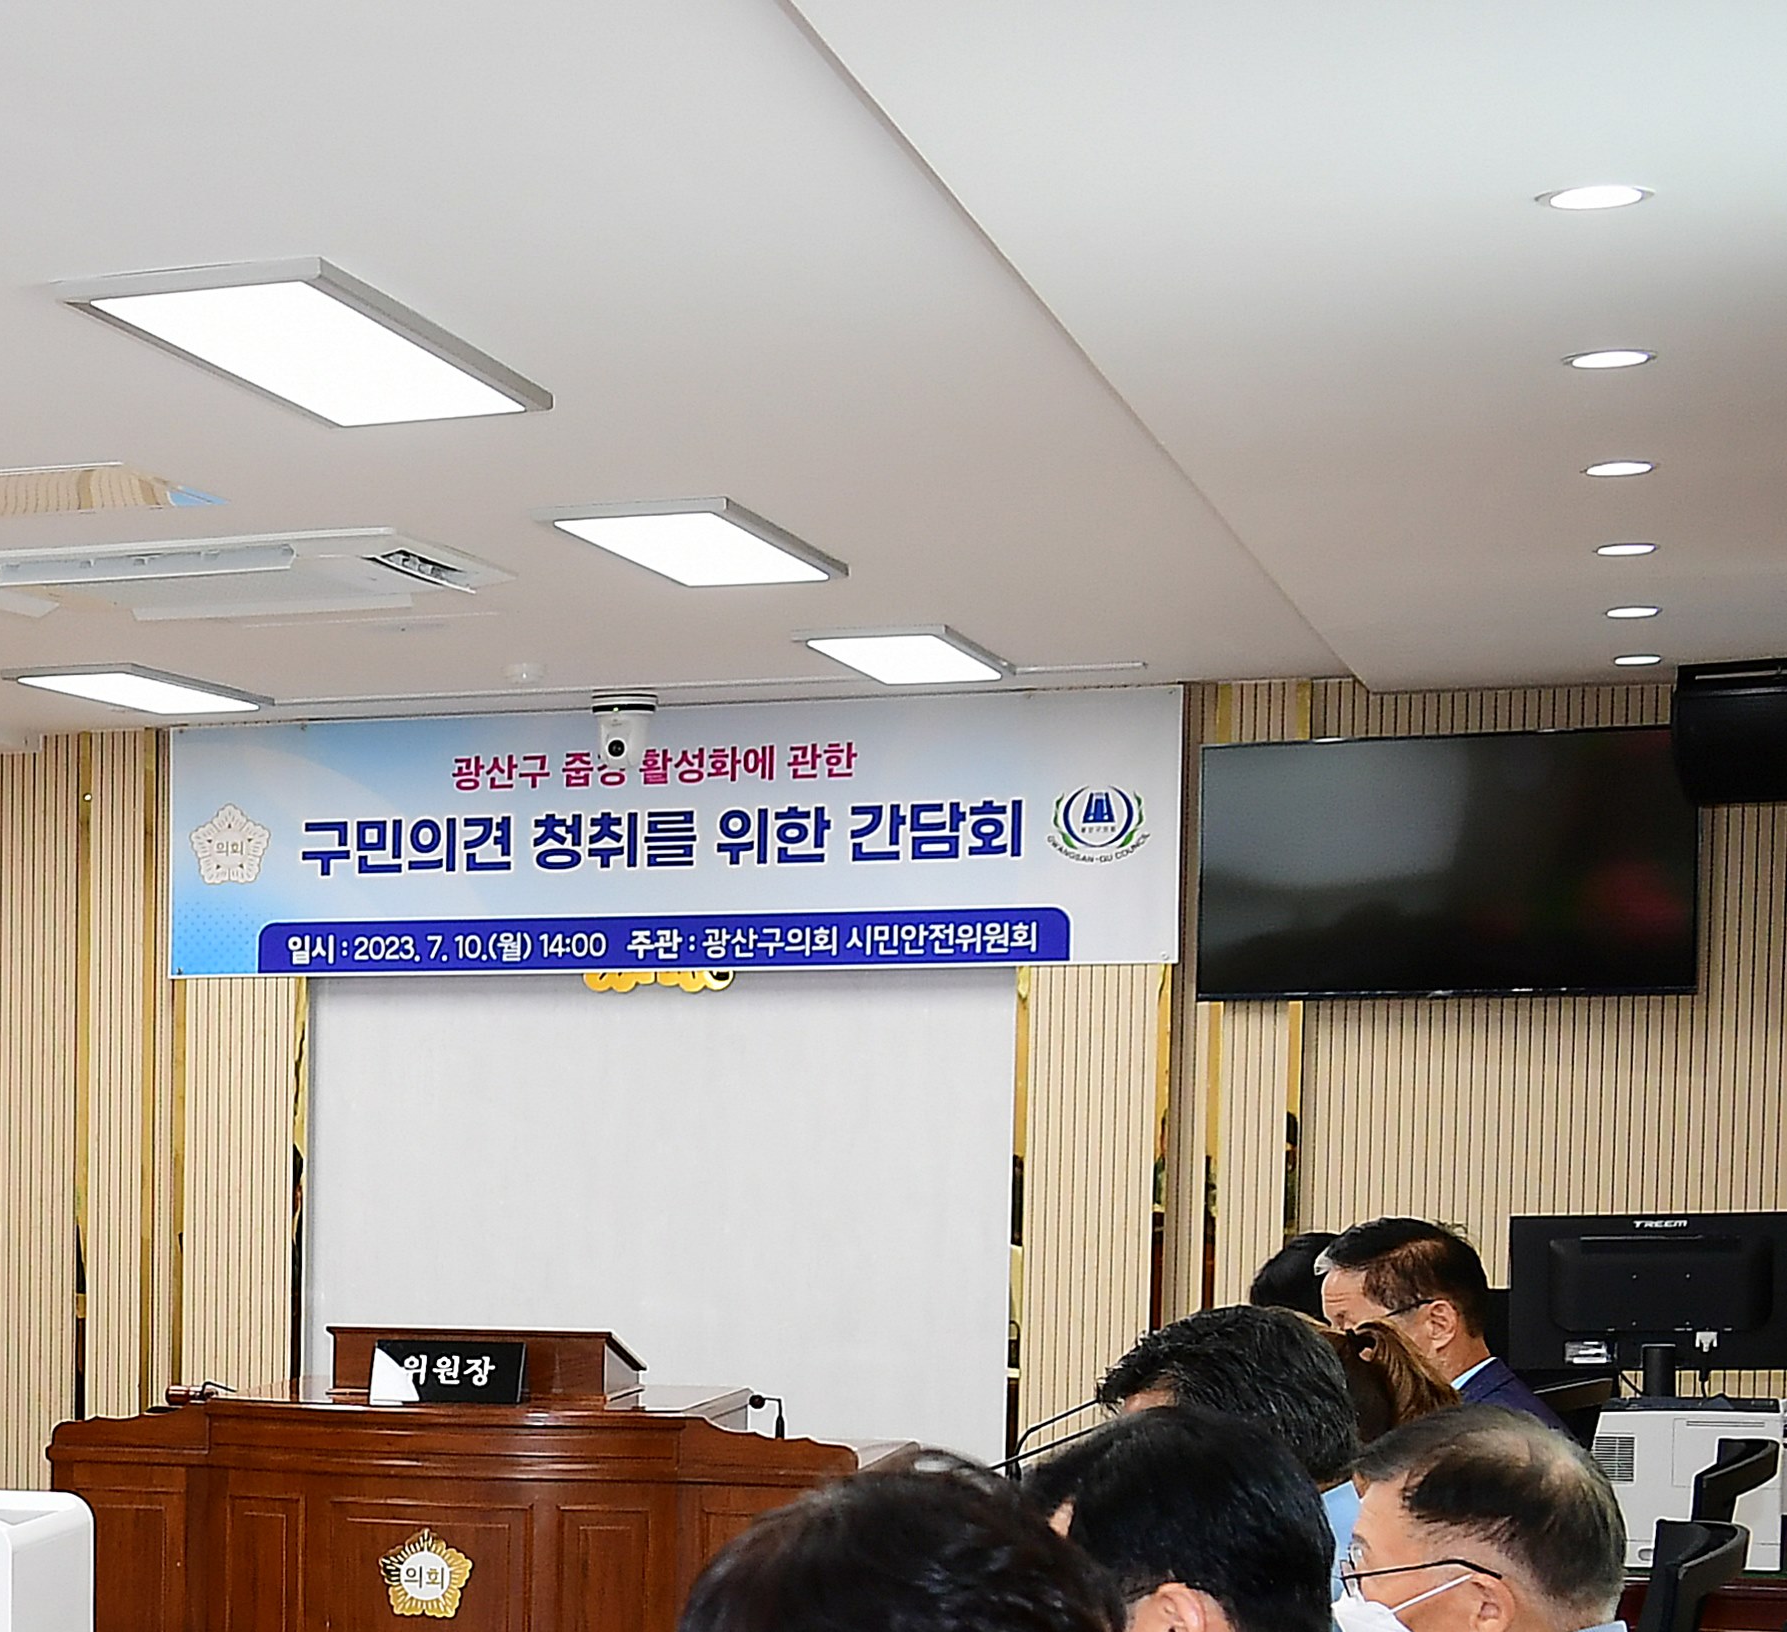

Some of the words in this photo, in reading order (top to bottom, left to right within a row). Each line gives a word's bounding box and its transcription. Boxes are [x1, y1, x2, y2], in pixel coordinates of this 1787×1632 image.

[452, 755, 551, 791] 광산구
[640, 744, 776, 784] 활성화에
[787, 741, 857, 779] 관한
[216, 840, 244, 857] 의회
[301, 815, 514, 876] 구민의견
[532, 809, 697, 870] 청취를
[716, 805, 831, 866] 위한
[850, 799, 1024, 863] 간담회
[353, 936, 421, 963] 2023.
[426, 935, 448, 962] 7.
[539, 933, 607, 960] 14:00
[702, 926, 838, 959] 광산구의회
[846, 922, 1039, 955] 시민안전위원회
[403, 1354, 496, 1387] 위원장
[404, 1565, 445, 1590] 의회
